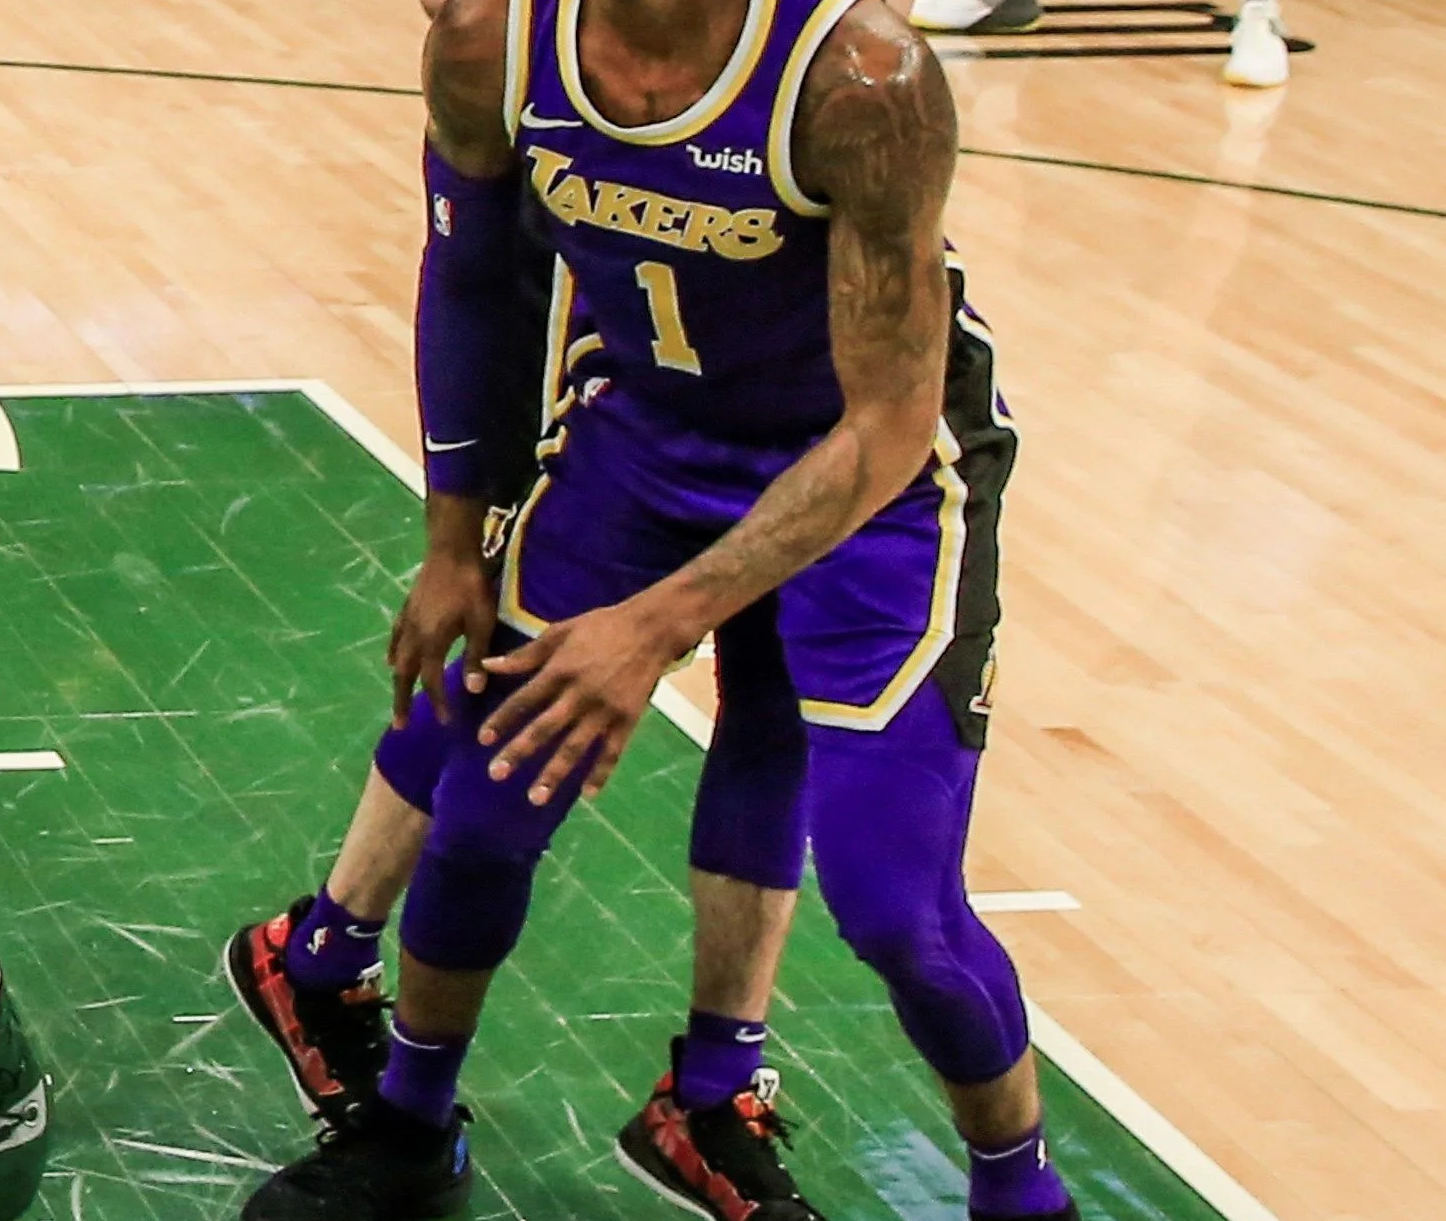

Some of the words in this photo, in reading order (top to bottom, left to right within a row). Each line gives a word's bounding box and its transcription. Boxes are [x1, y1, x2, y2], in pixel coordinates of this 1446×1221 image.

[527, 145, 785, 260] LAKERS
[685, 143, 763, 175] wish
[635, 260, 703, 377] 1
